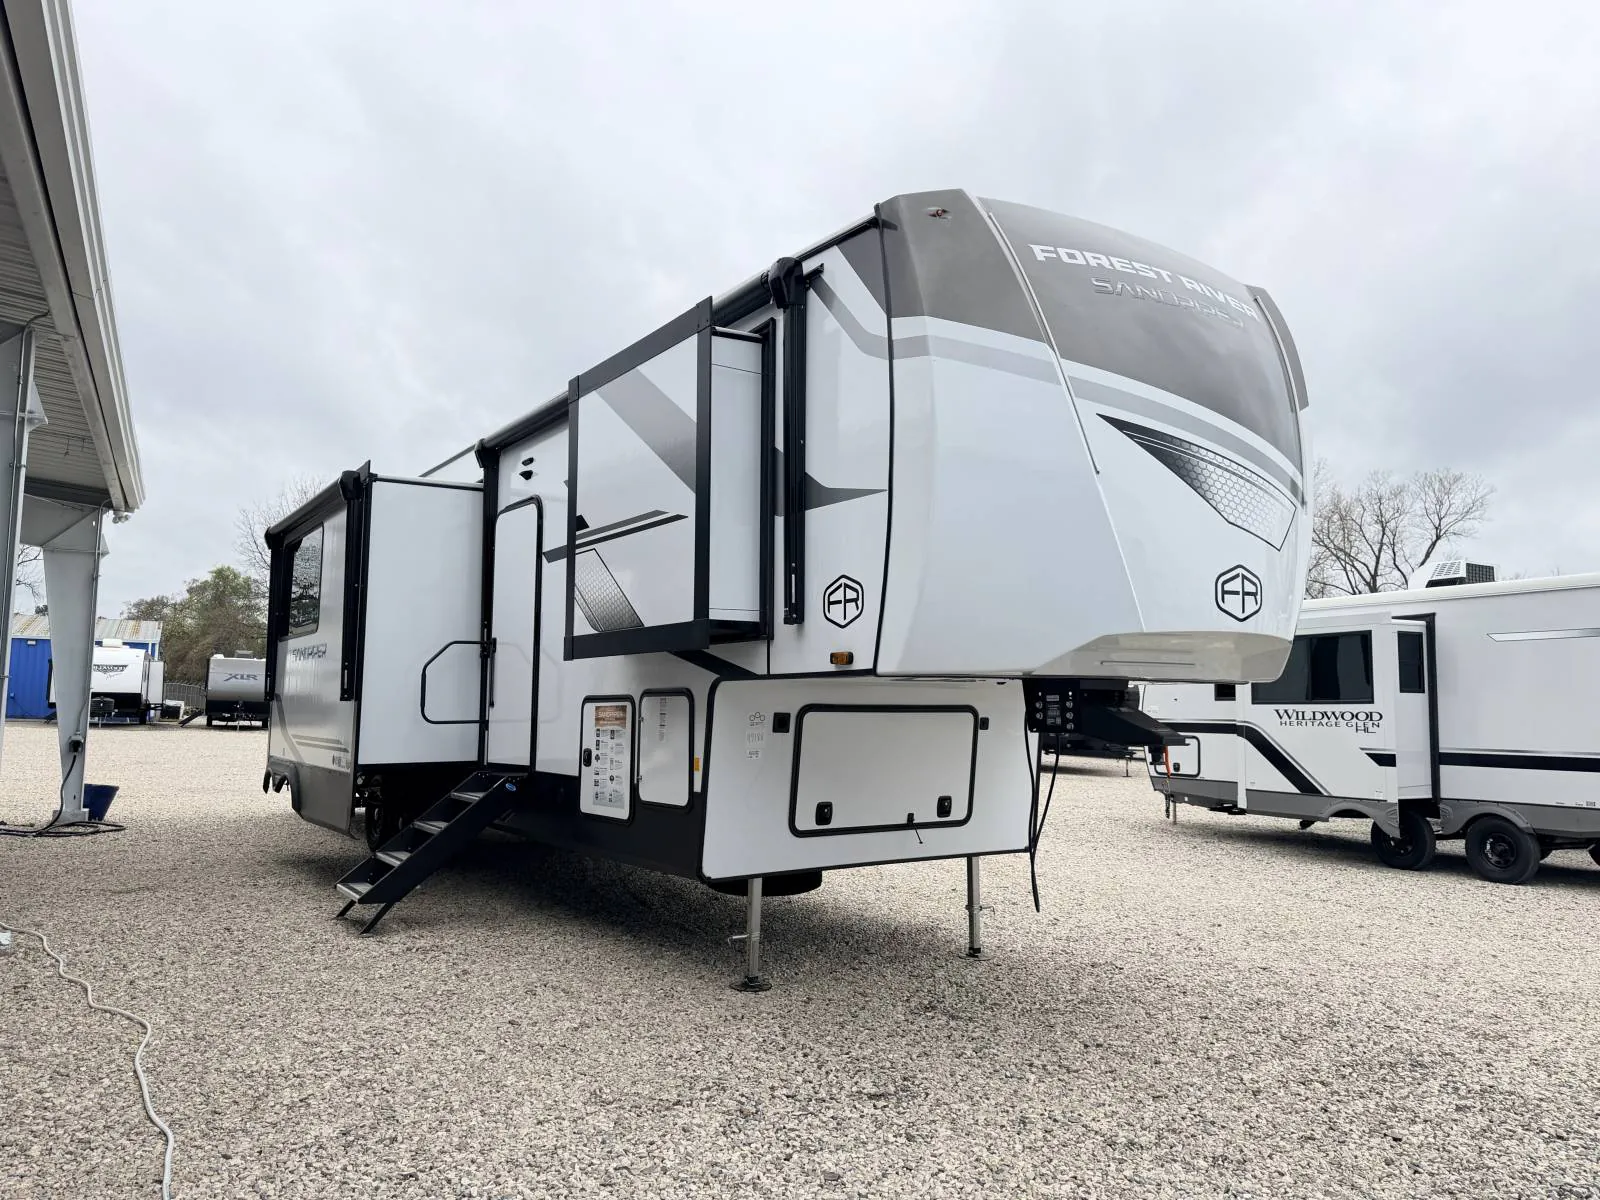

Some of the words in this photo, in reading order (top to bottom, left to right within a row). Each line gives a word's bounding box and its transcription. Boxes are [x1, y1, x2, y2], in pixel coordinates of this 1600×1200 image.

[1028, 243, 1173, 283] FOREST
[1176, 274, 1261, 324] RIVER
[223, 673, 258, 682] XLR
[1273, 708, 1384, 722] WILDWOOD
[1280, 720, 1341, 728] HERITAGE
[1345, 721, 1380, 729] GLEN
